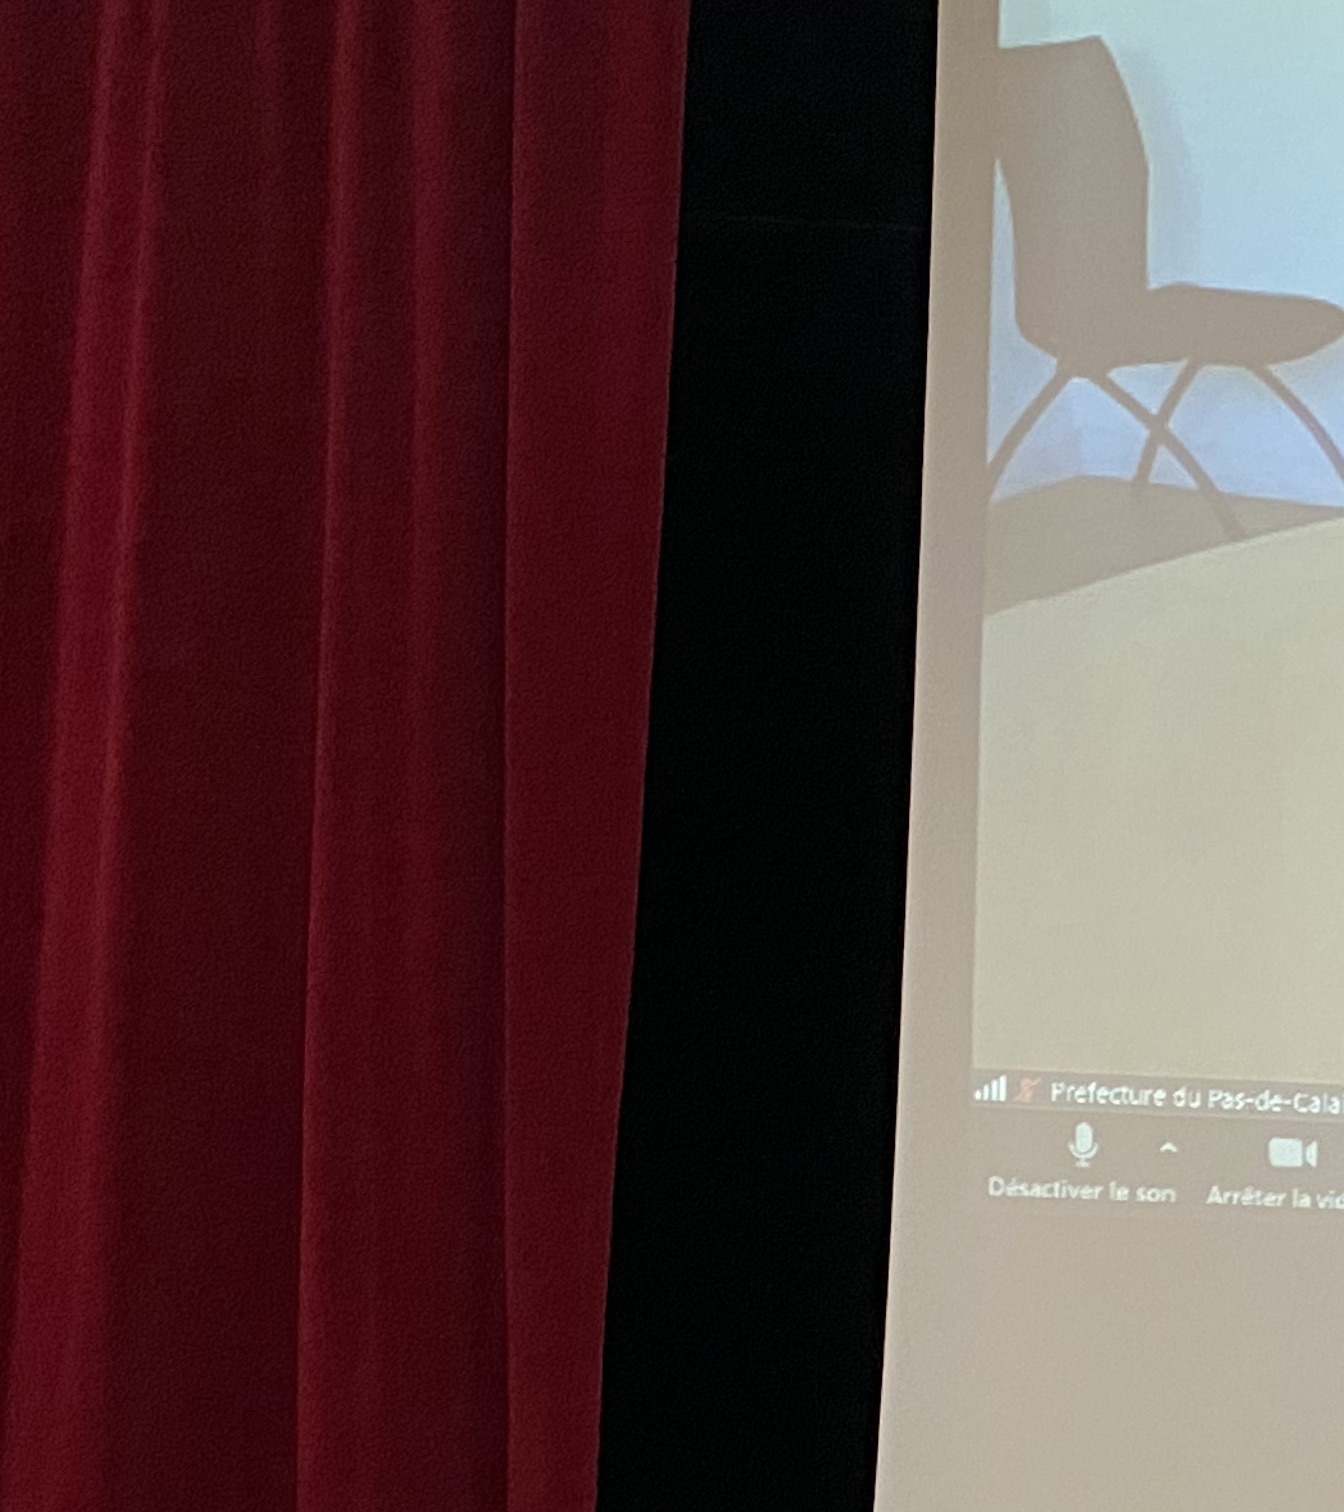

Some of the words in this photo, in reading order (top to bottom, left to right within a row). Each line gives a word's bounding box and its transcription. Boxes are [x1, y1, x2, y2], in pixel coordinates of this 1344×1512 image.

[1172, 1085, 1201, 1109] du
[987, 1175, 1104, 1201] Désactiver
[1108, 1180, 1131, 1201] le
[1135, 1185, 1177, 1203] son
[1291, 1188, 1312, 1209] la
